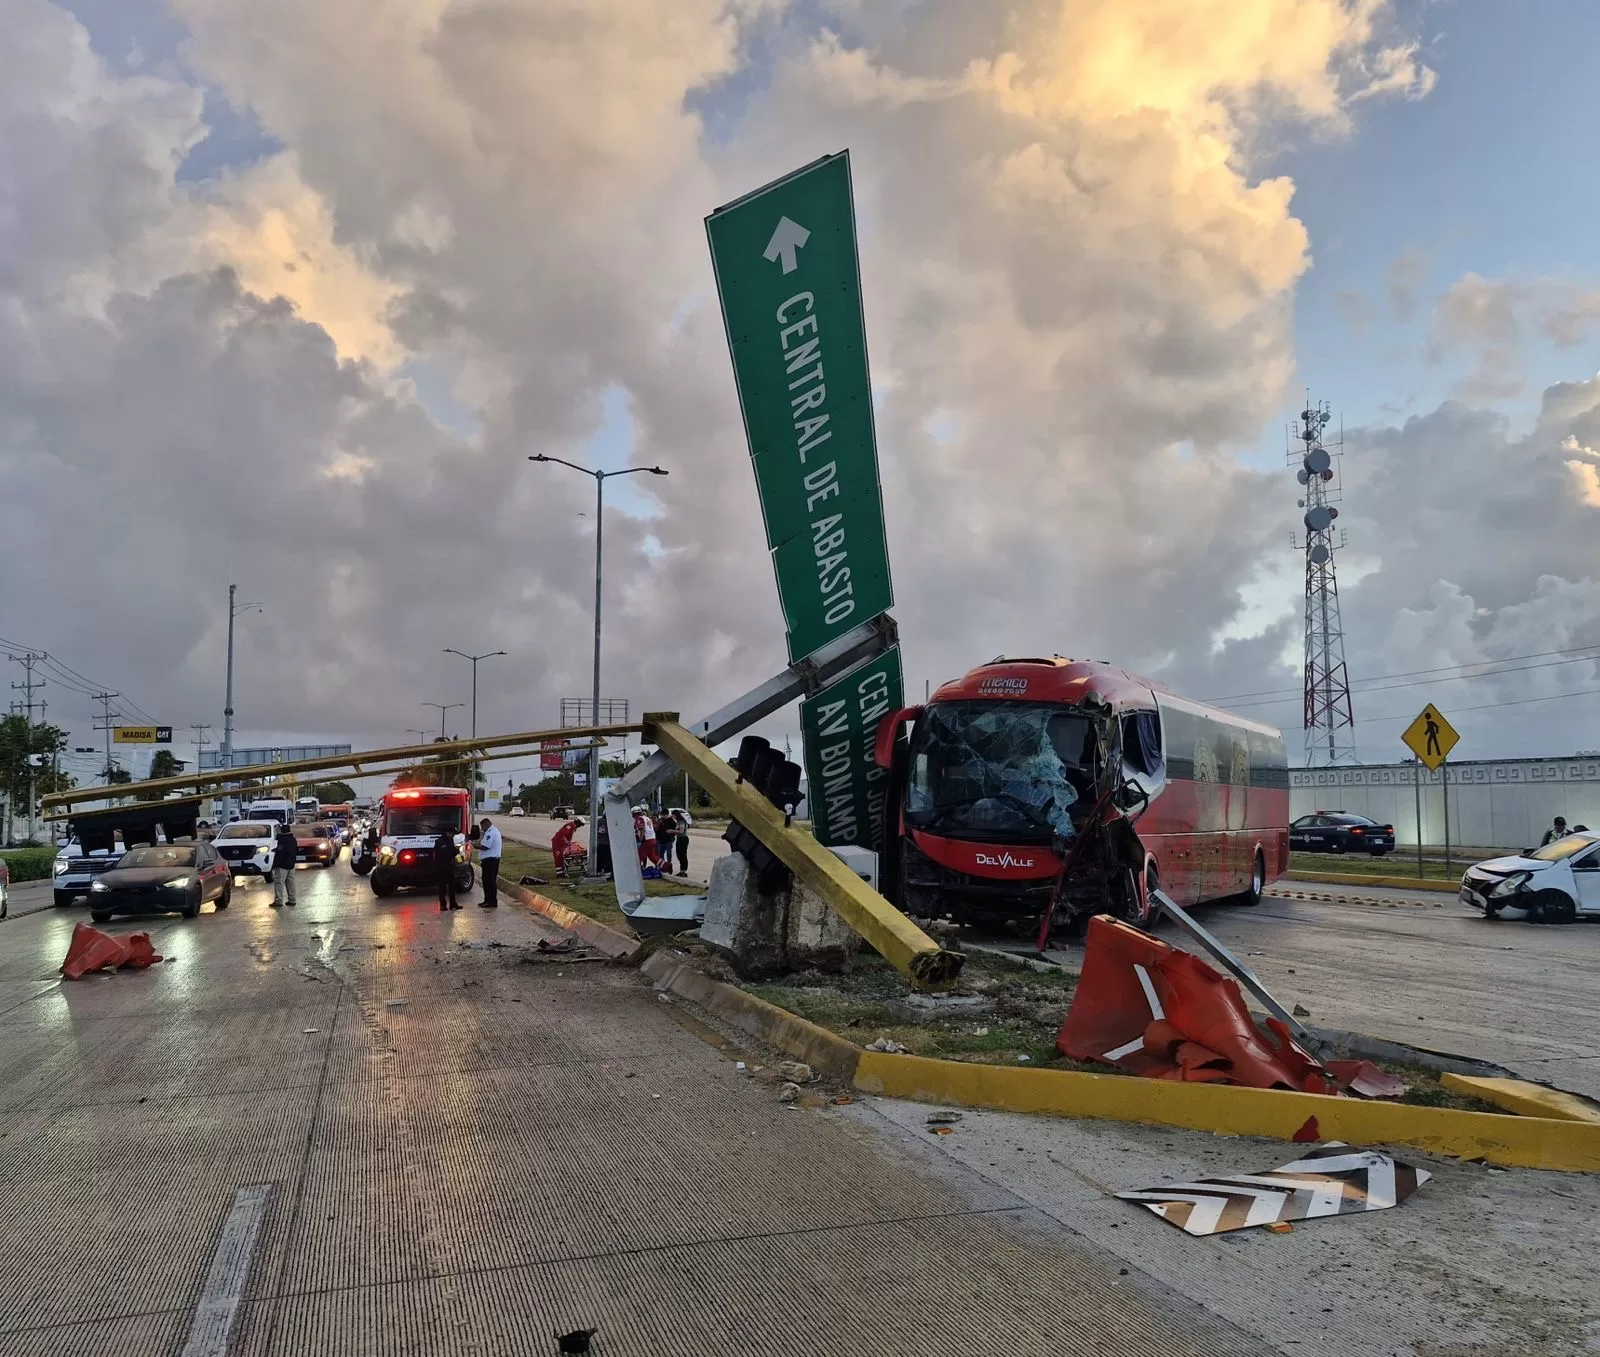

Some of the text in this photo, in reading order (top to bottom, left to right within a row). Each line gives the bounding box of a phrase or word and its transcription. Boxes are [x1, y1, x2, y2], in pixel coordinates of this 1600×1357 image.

[776, 291, 856, 626] CENTRAL DE ABASTO
[816, 698, 850, 737] AV
[122, 731, 151, 739] MADISA
[157, 731, 170, 739] CAT
